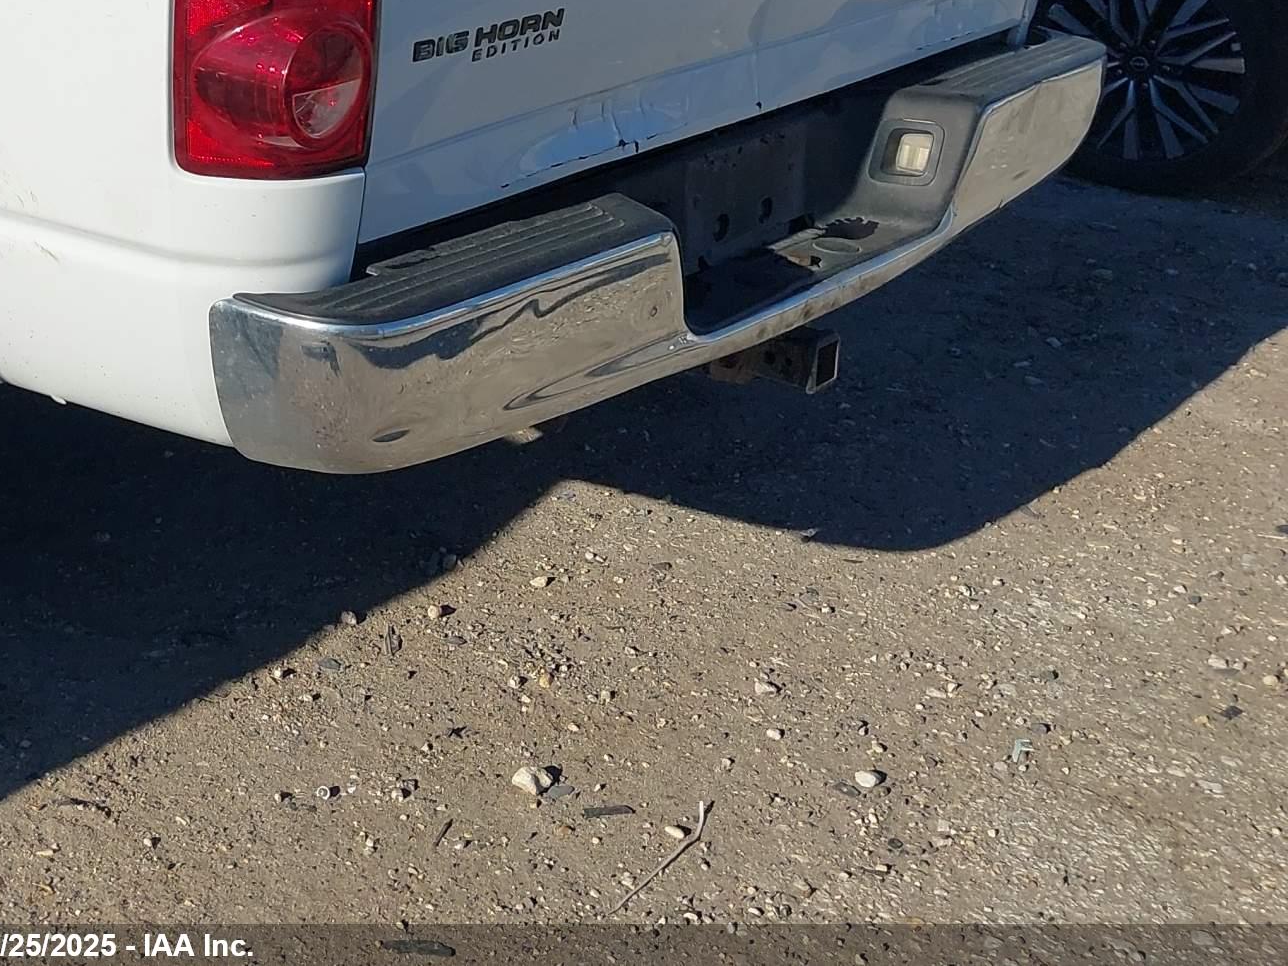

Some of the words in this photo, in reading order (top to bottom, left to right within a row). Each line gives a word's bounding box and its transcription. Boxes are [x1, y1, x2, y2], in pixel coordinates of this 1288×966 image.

[412, 31, 470, 63] BIG
[474, 8, 565, 48] HORN
[471, 29, 560, 62] EDITION
